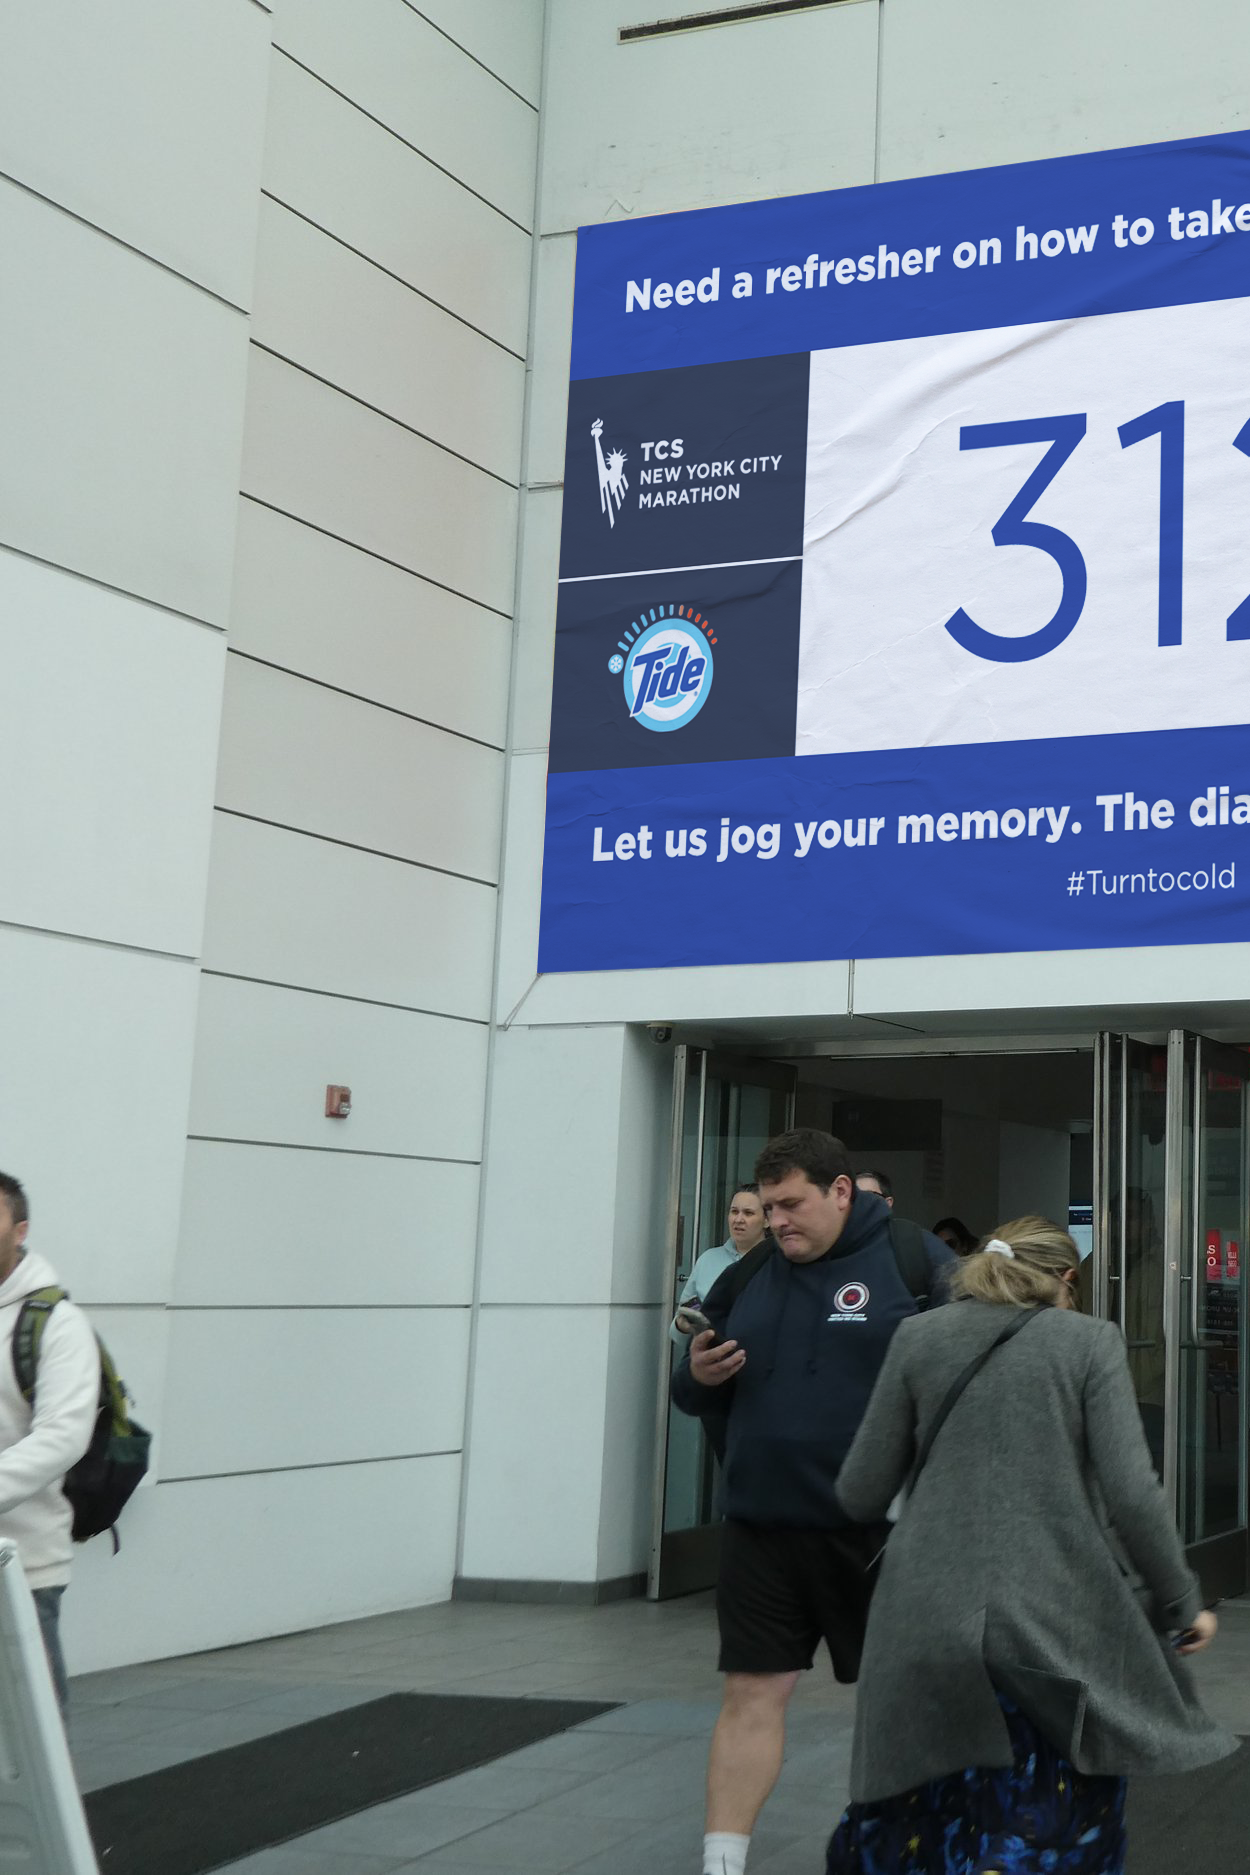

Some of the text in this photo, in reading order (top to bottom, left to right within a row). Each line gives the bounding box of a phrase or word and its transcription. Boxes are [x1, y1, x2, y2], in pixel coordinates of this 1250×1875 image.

[626, 267, 720, 312] Need
[732, 272, 752, 298] a
[766, 245, 941, 294] refresher
[953, 238, 1001, 268] on
[1016, 224, 1099, 261] how
[1112, 215, 1154, 248] to
[641, 439, 683, 461] TCS
[640, 455, 782, 485] NEW YORK CITY
[639, 484, 740, 509] MARATHON
[631, 644, 706, 716] Tide
[593, 826, 652, 861] Let
[666, 828, 707, 857] us
[717, 818, 780, 862] jog
[794, 817, 885, 857] your
[898, 806, 1081, 843] memory.
[1096, 792, 1174, 831] The
[1067, 862, 1234, 896] #Turntocold
